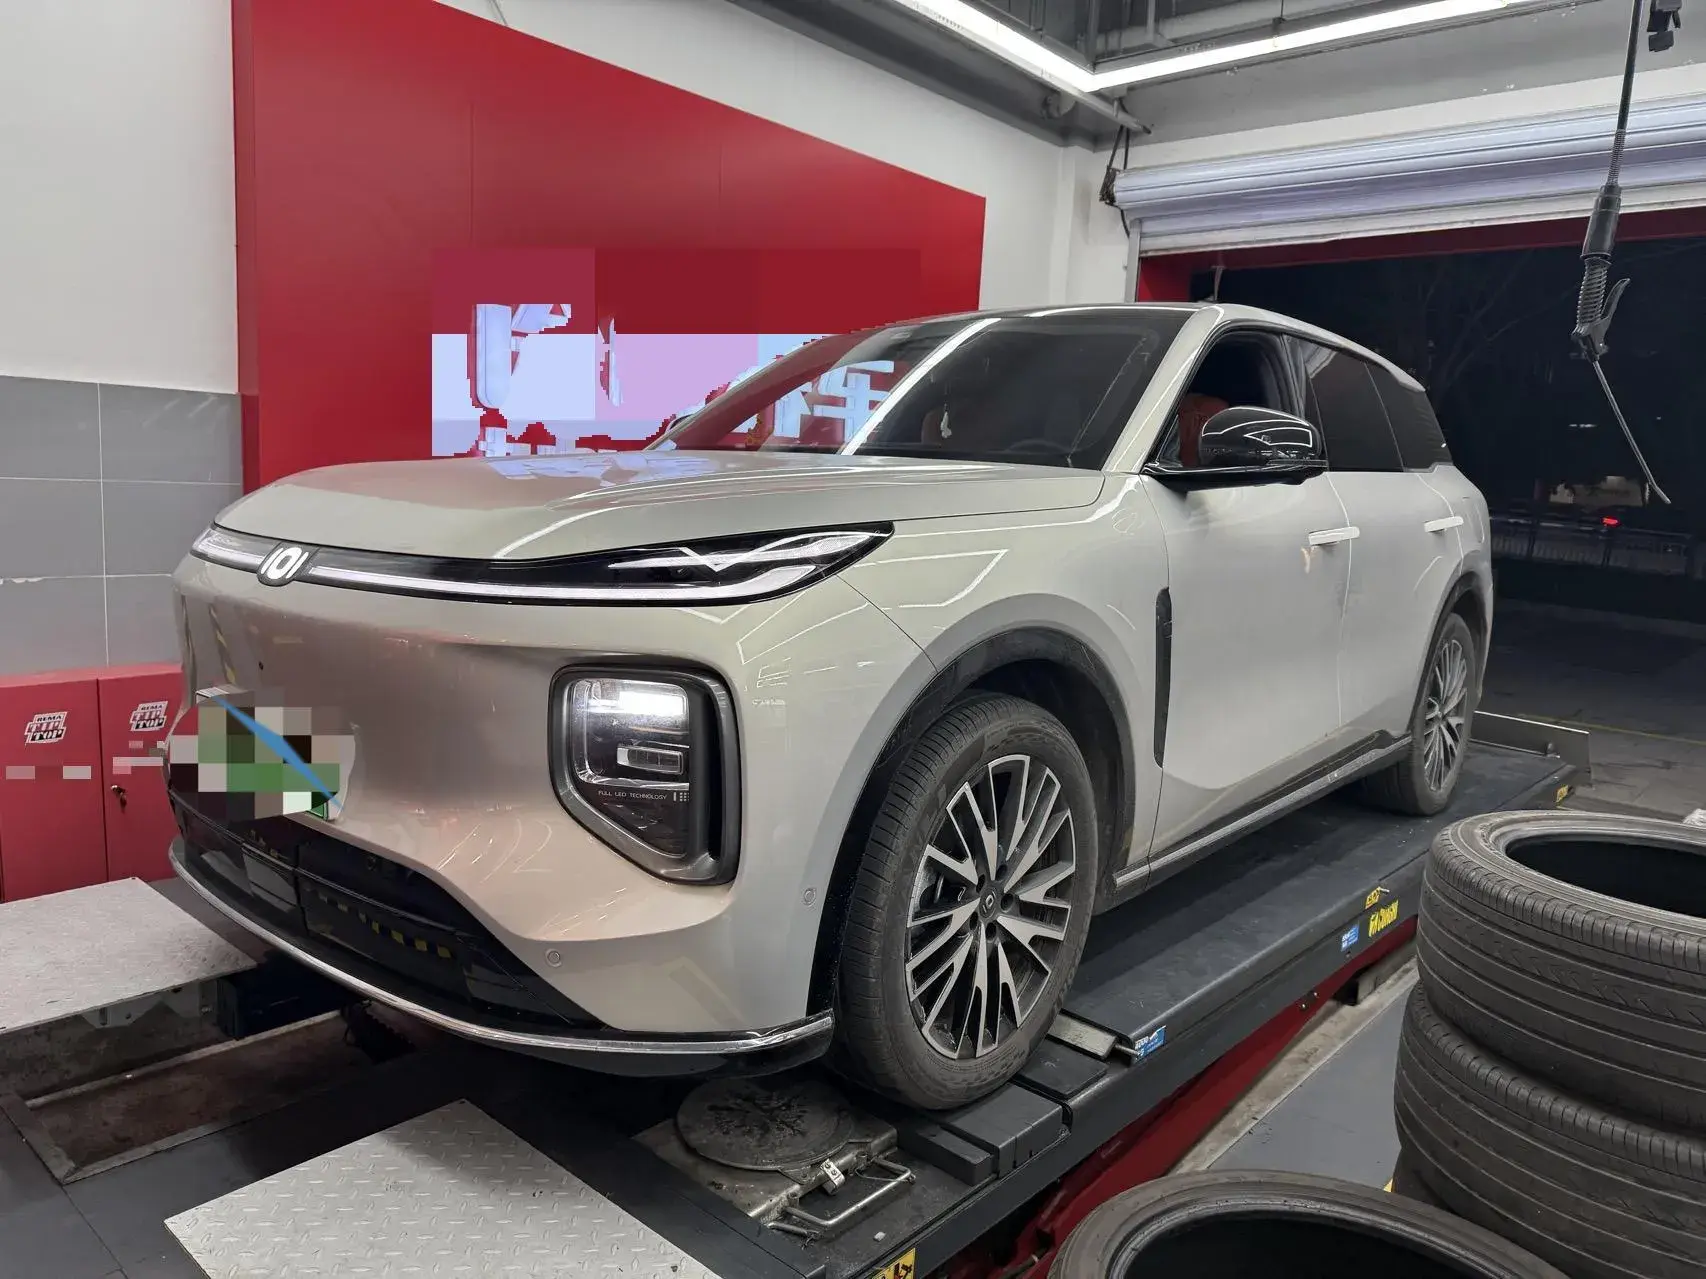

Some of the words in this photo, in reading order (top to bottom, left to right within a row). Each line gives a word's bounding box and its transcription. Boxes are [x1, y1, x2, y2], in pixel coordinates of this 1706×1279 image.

[32, 720, 60, 732] TIP
[137, 718, 164, 729] TOP
[34, 729, 63, 741] TOP
